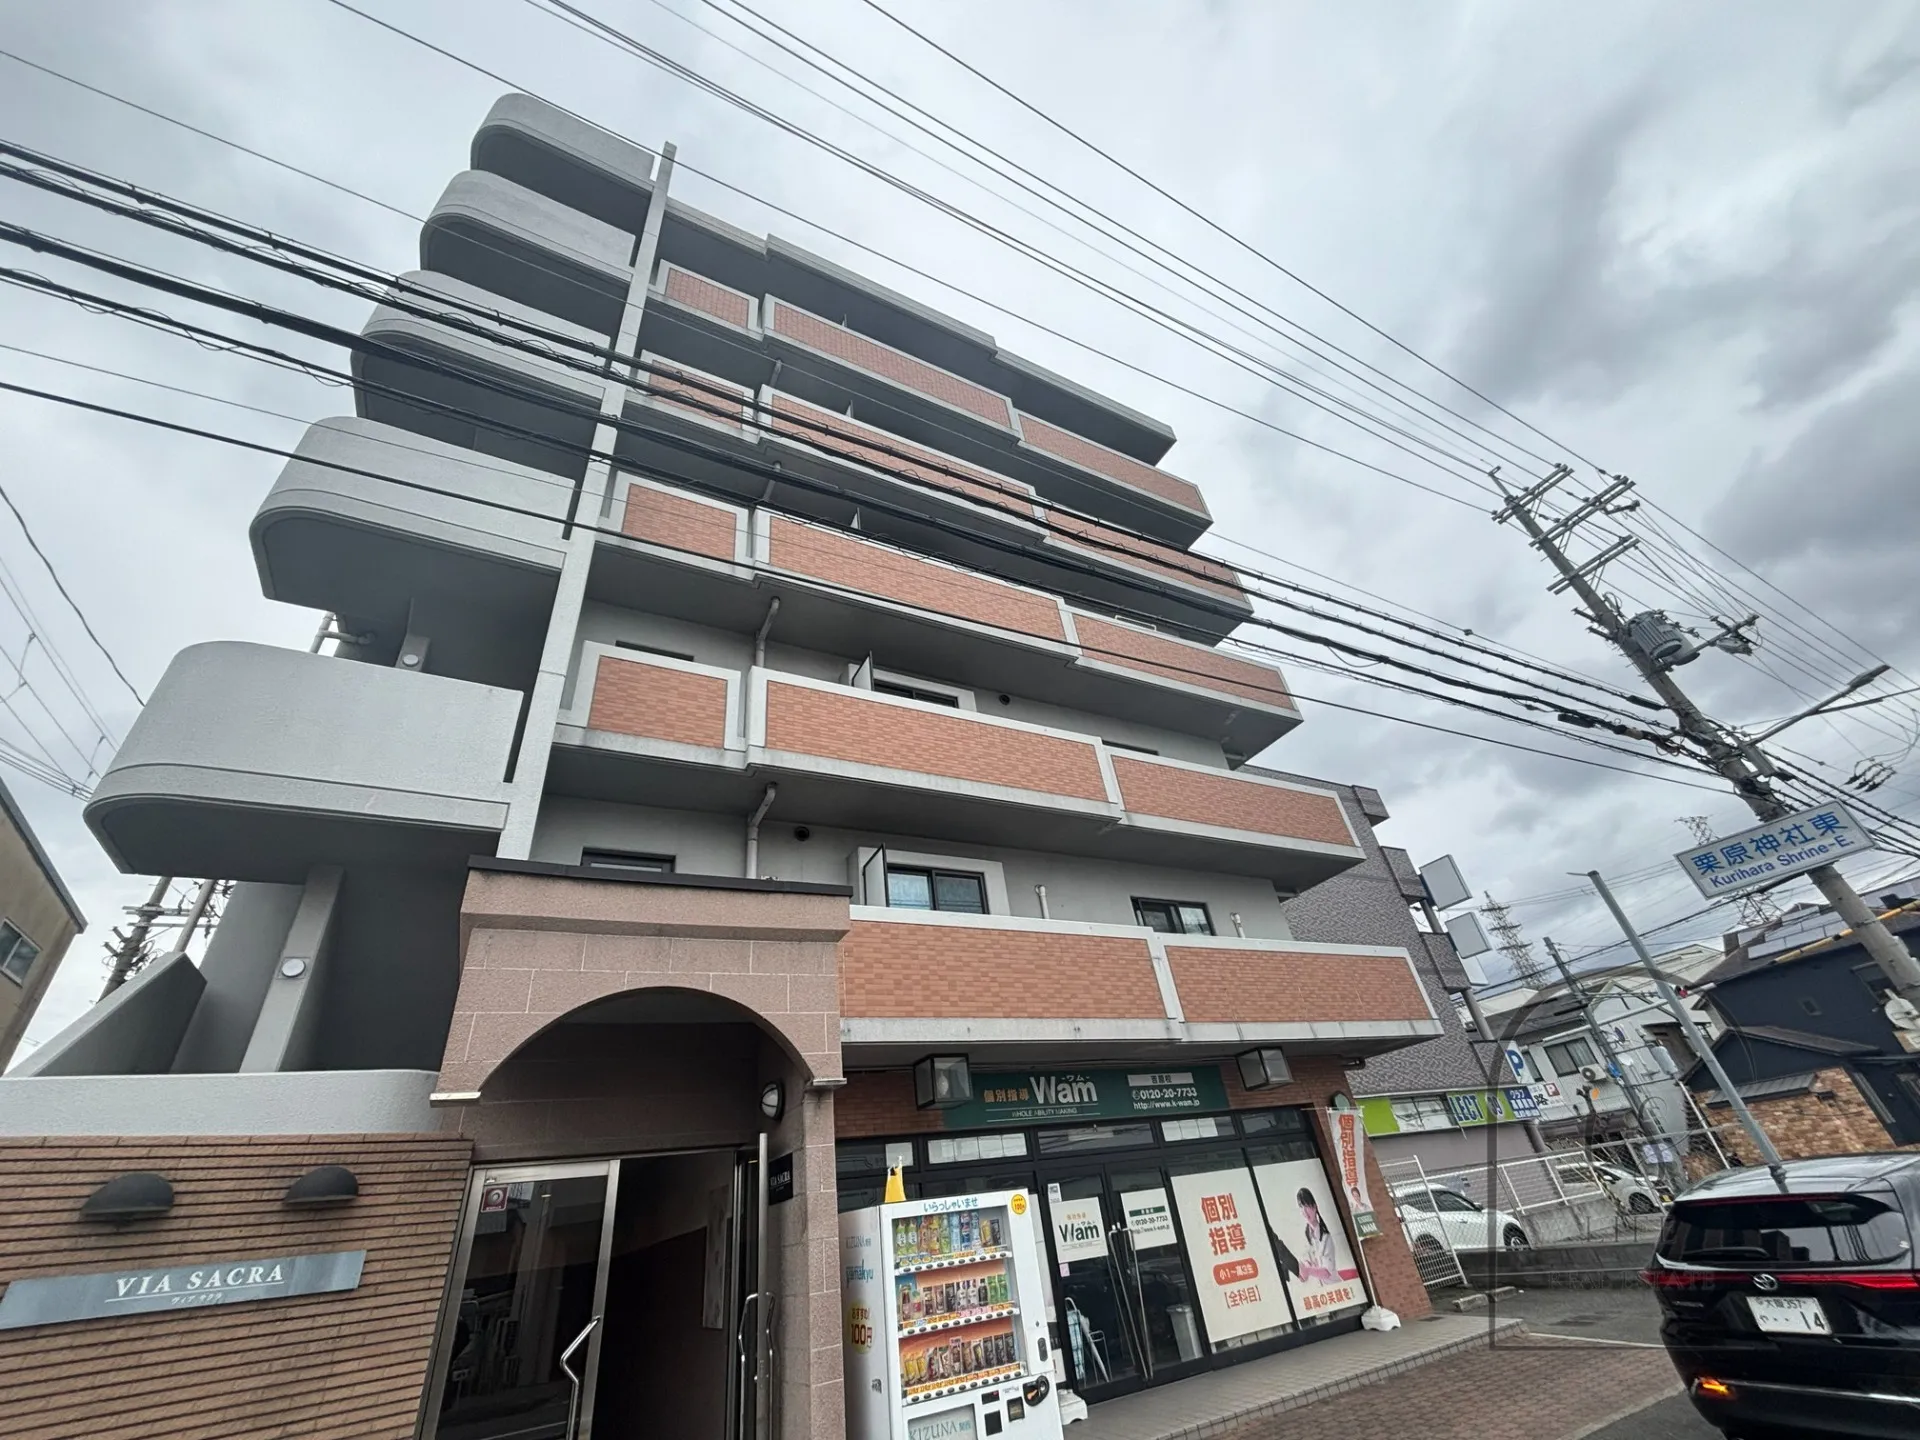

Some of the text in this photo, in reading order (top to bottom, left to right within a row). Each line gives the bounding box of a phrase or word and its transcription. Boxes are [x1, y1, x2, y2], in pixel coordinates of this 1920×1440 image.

[1691, 811, 1849, 876] 栗原神社東
[1709, 834, 1855, 889] Kurihara Shrine-E.
[984, 1076, 1098, 1105] 個別指導 Wam
[1133, 1098, 1200, 1110] http://www.k-wam.jp
[1140, 1087, 1198, 1100] 0120-20-7733
[1055, 1107, 1078, 1115] MAKING
[1449, 1094, 1485, 1123] LECT
[1340, 1114, 1359, 1187] 個別指導
[923, 1197, 979, 1213] いらっしゃいませ
[1200, 1193, 1238, 1225] 個別
[1058, 1223, 1100, 1243] Wam
[1208, 1224, 1247, 1256] 指導
[116, 1262, 284, 1297] VIA SACRA
[909, 1420, 957, 1440] KIZUNA
